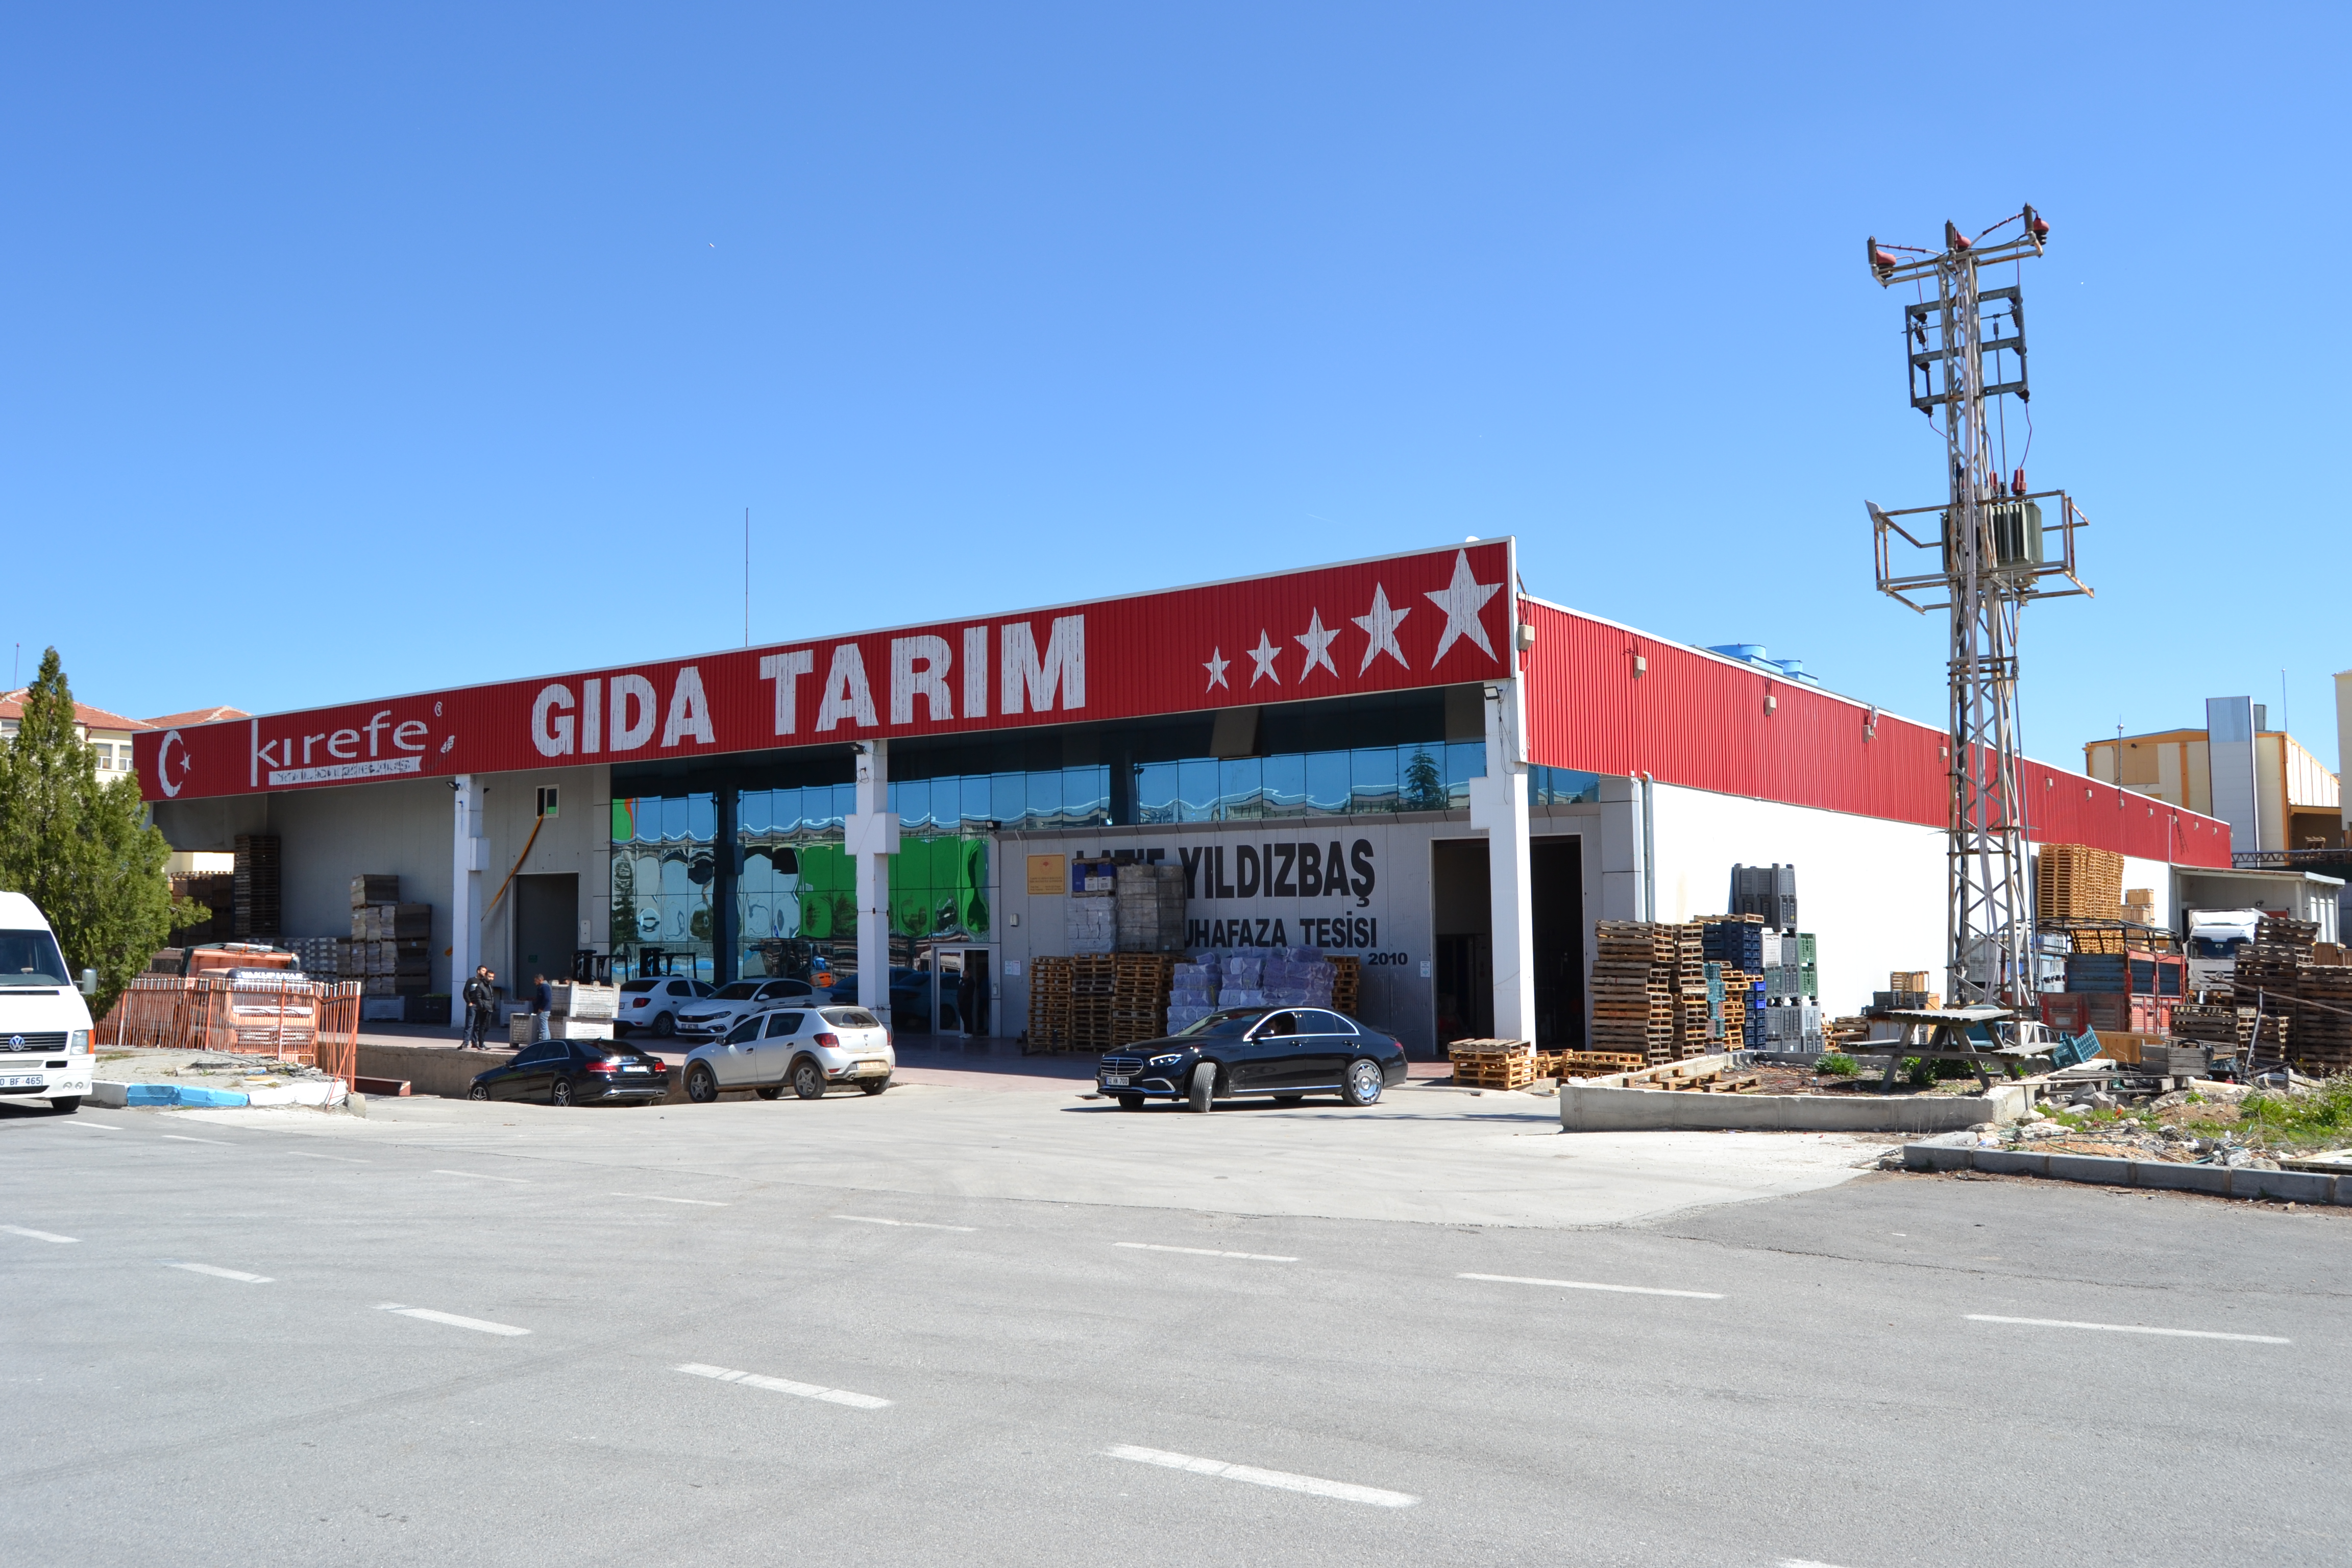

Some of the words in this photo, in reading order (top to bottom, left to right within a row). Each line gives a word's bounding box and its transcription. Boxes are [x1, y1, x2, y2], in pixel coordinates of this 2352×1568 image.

[532, 666, 716, 757] GIDA
[760, 614, 1085, 736] TARIM
[1179, 839, 1375, 907] YILDIZBAŞ
[1185, 918, 1287, 948] UHAFAZA
[1368, 952, 1408, 965] 2010
